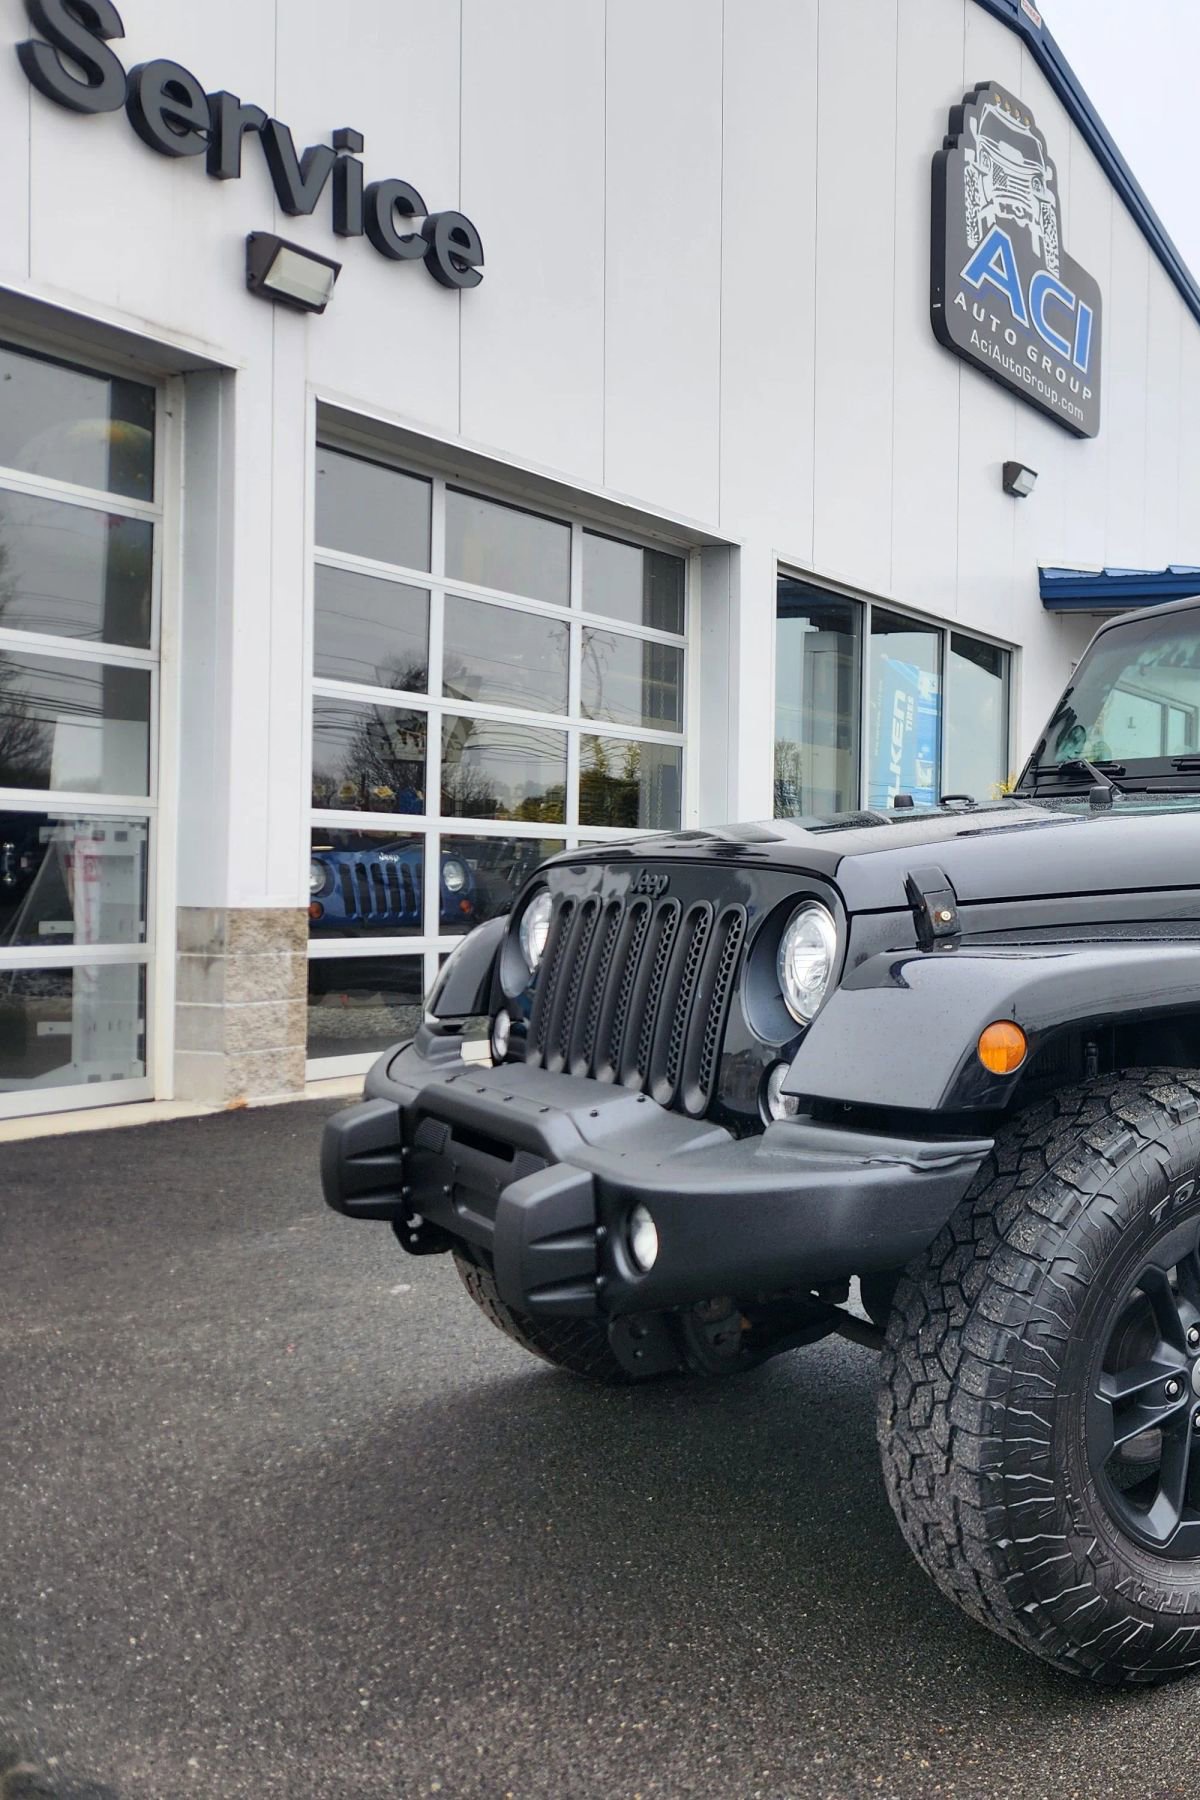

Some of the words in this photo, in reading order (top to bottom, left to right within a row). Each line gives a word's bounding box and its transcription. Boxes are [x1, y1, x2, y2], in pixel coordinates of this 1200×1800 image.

[16, 0, 485, 290] Service
[953, 291, 1018, 346] AUTO
[1026, 345, 1093, 400] GROUP
[959, 224, 1094, 375] ACI
[970, 329, 1085, 422] AciAutoGroup.com
[629, 868, 670, 900] Jeep
